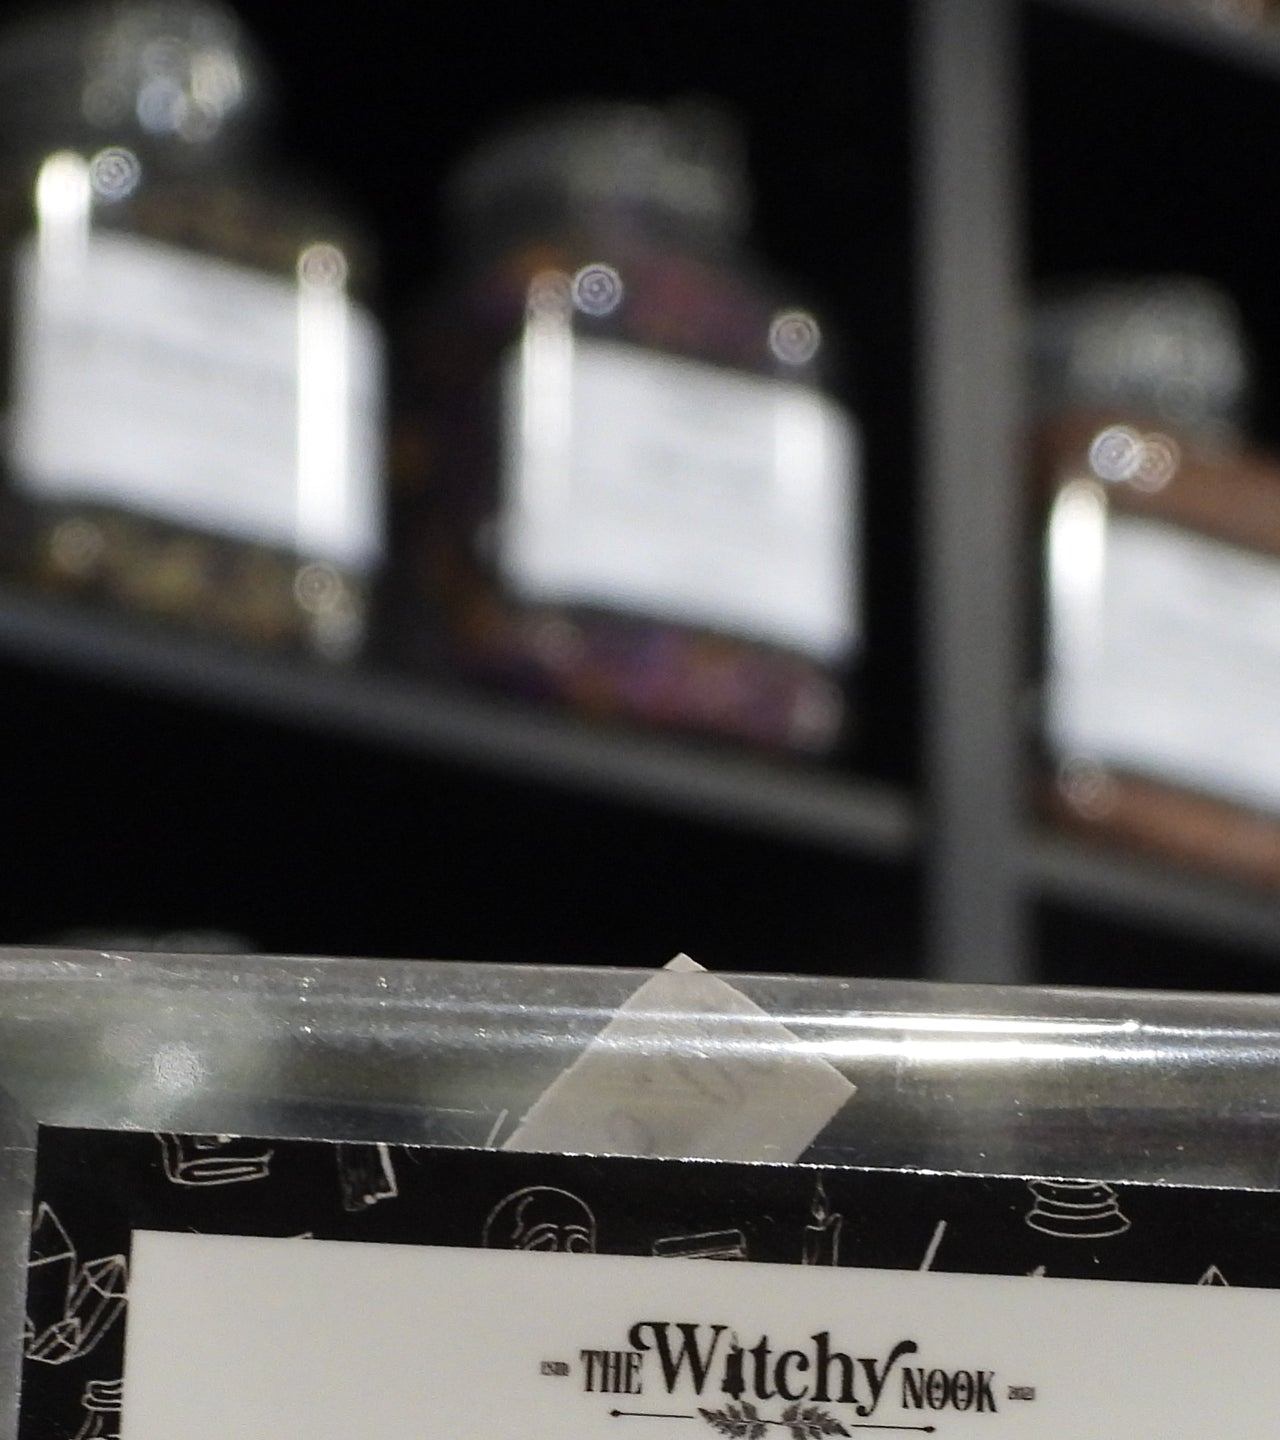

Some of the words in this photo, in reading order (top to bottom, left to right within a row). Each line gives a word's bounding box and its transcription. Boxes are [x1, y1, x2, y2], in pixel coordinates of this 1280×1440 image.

[579, 1349, 644, 1395] THE
[627, 1321, 918, 1418] Witchy
[901, 1367, 999, 1413] NOOK
